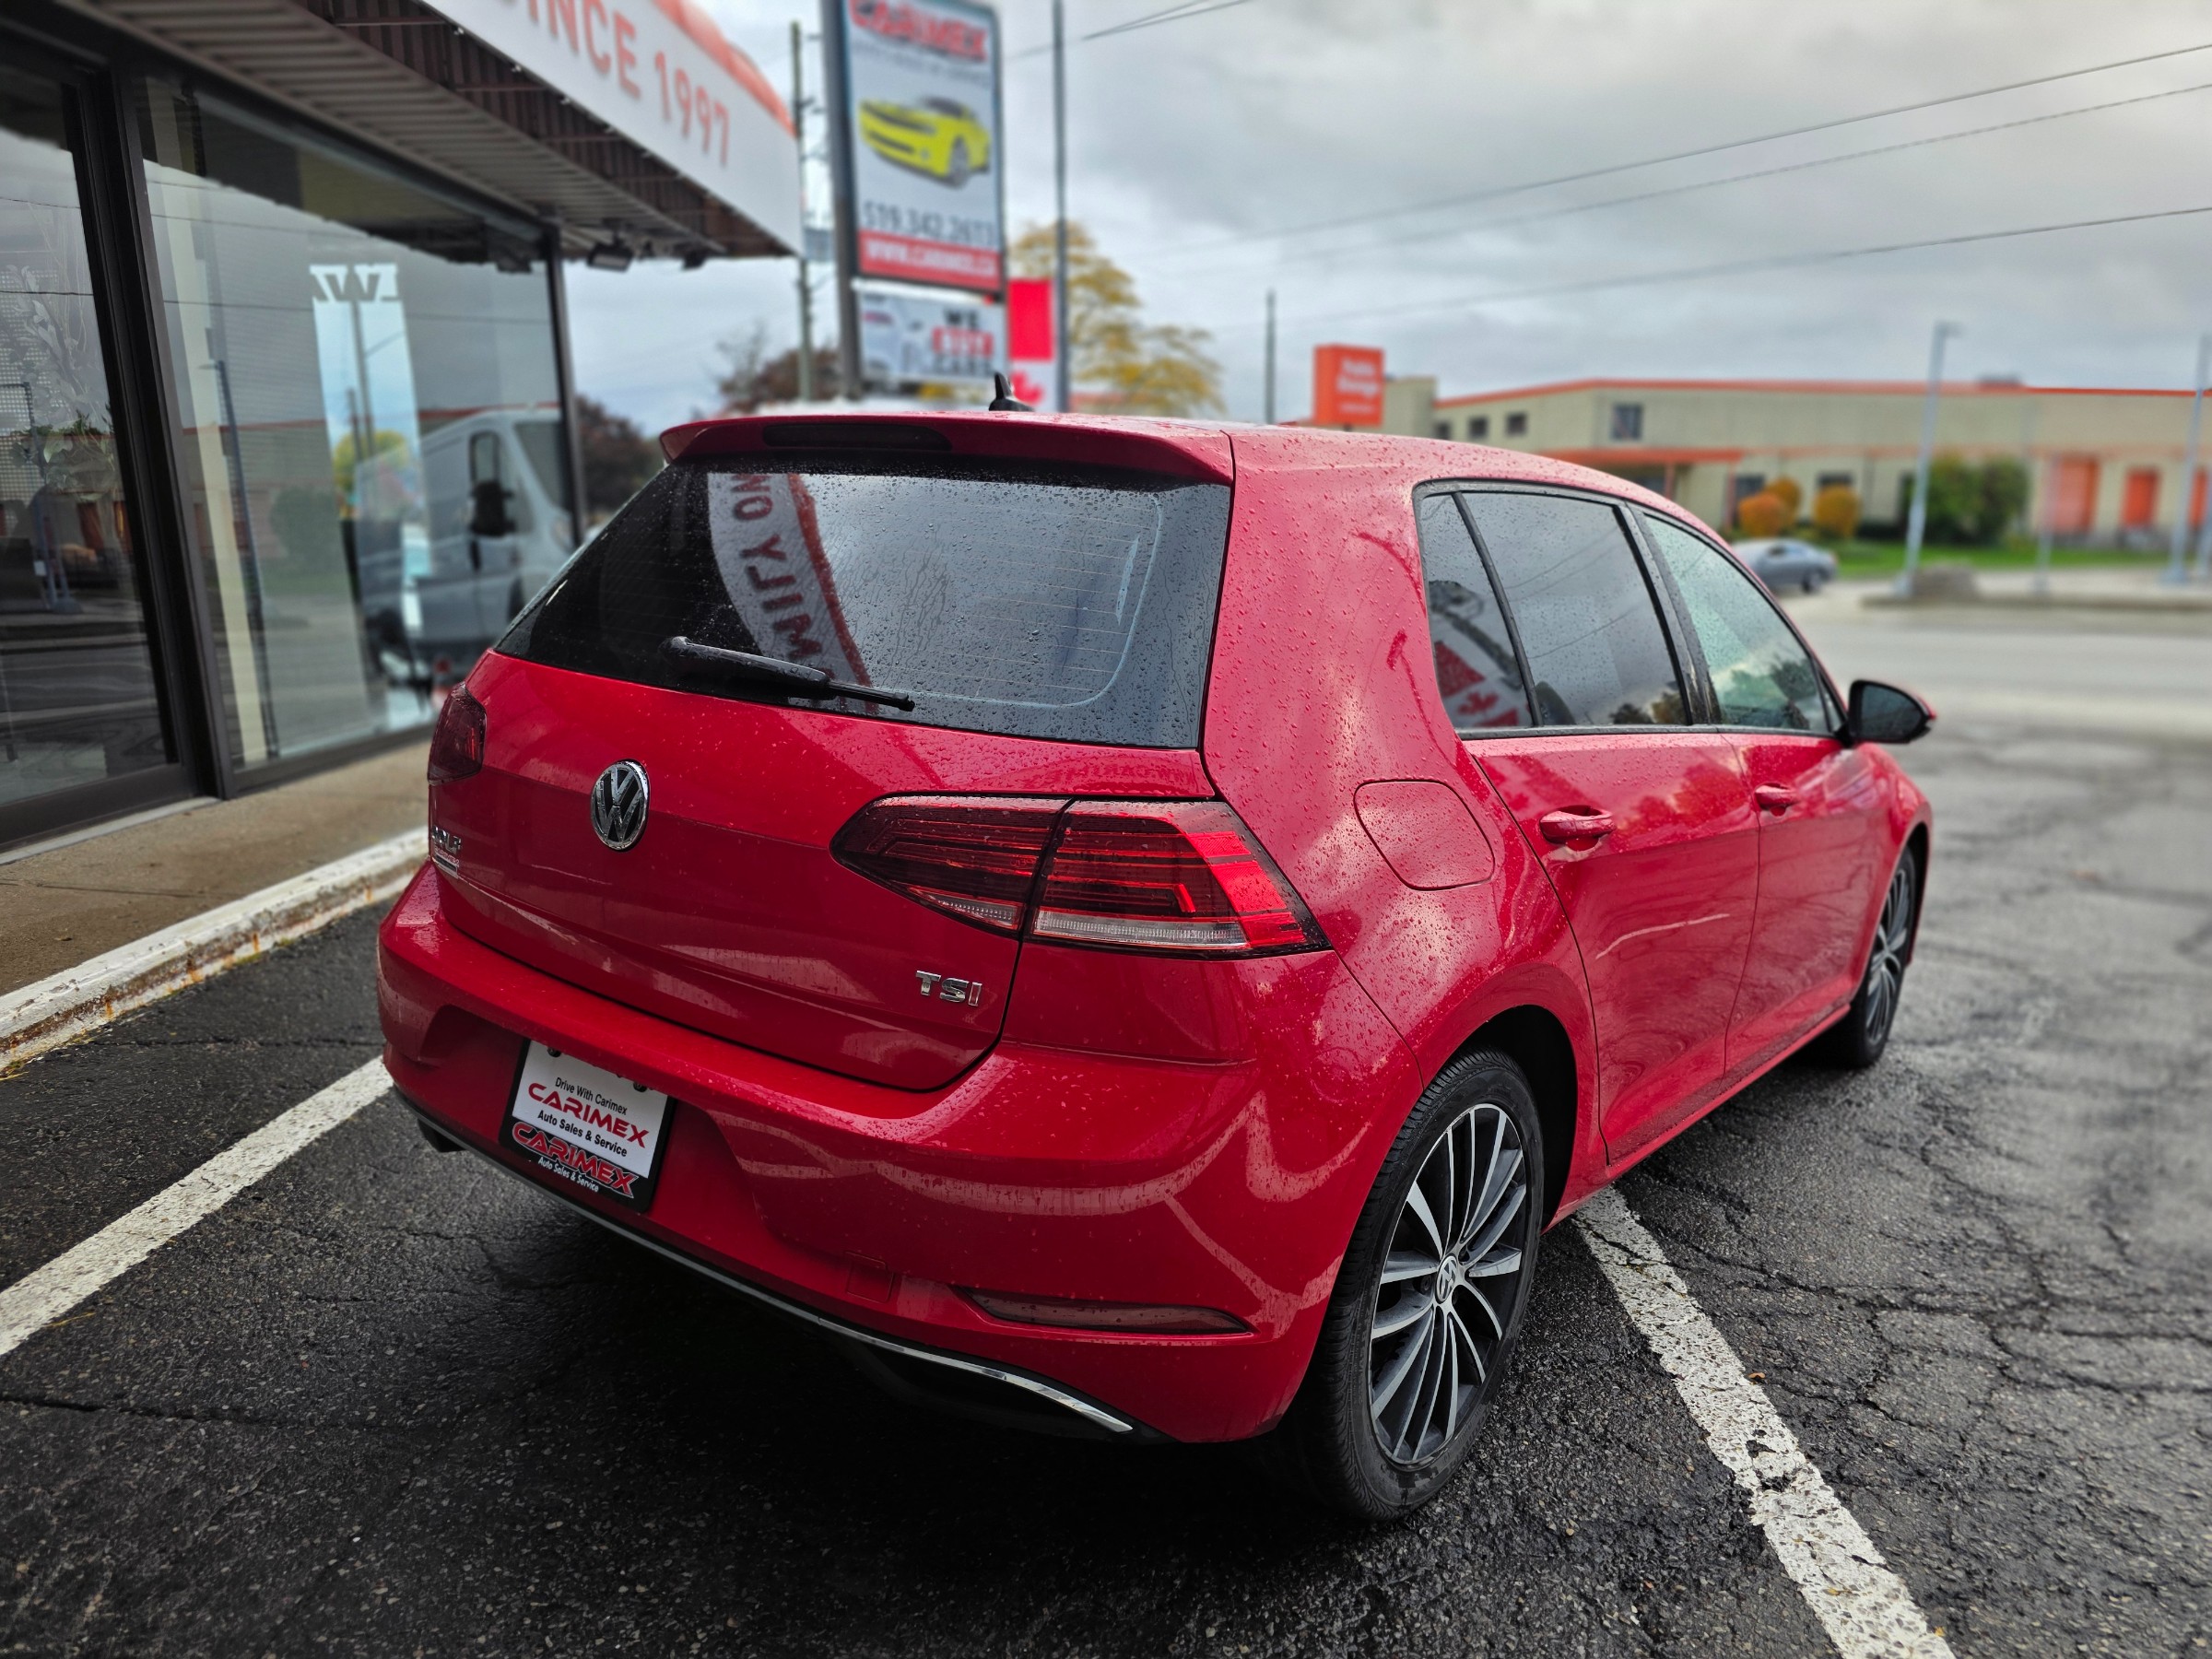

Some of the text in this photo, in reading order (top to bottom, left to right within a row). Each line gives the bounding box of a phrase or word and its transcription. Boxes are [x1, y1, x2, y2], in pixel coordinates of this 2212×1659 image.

[654, 51, 730, 168] 1997
[915, 970, 983, 1006] TSI
[528, 1082, 650, 1148] CARIMEX
[555, 1077, 628, 1115] Drive With Carimex
[537, 1110, 628, 1157] Auto Sales & Service
[512, 1121, 639, 1198] CARIMEX
[537, 1156, 599, 1193] Auto Sales & Service
